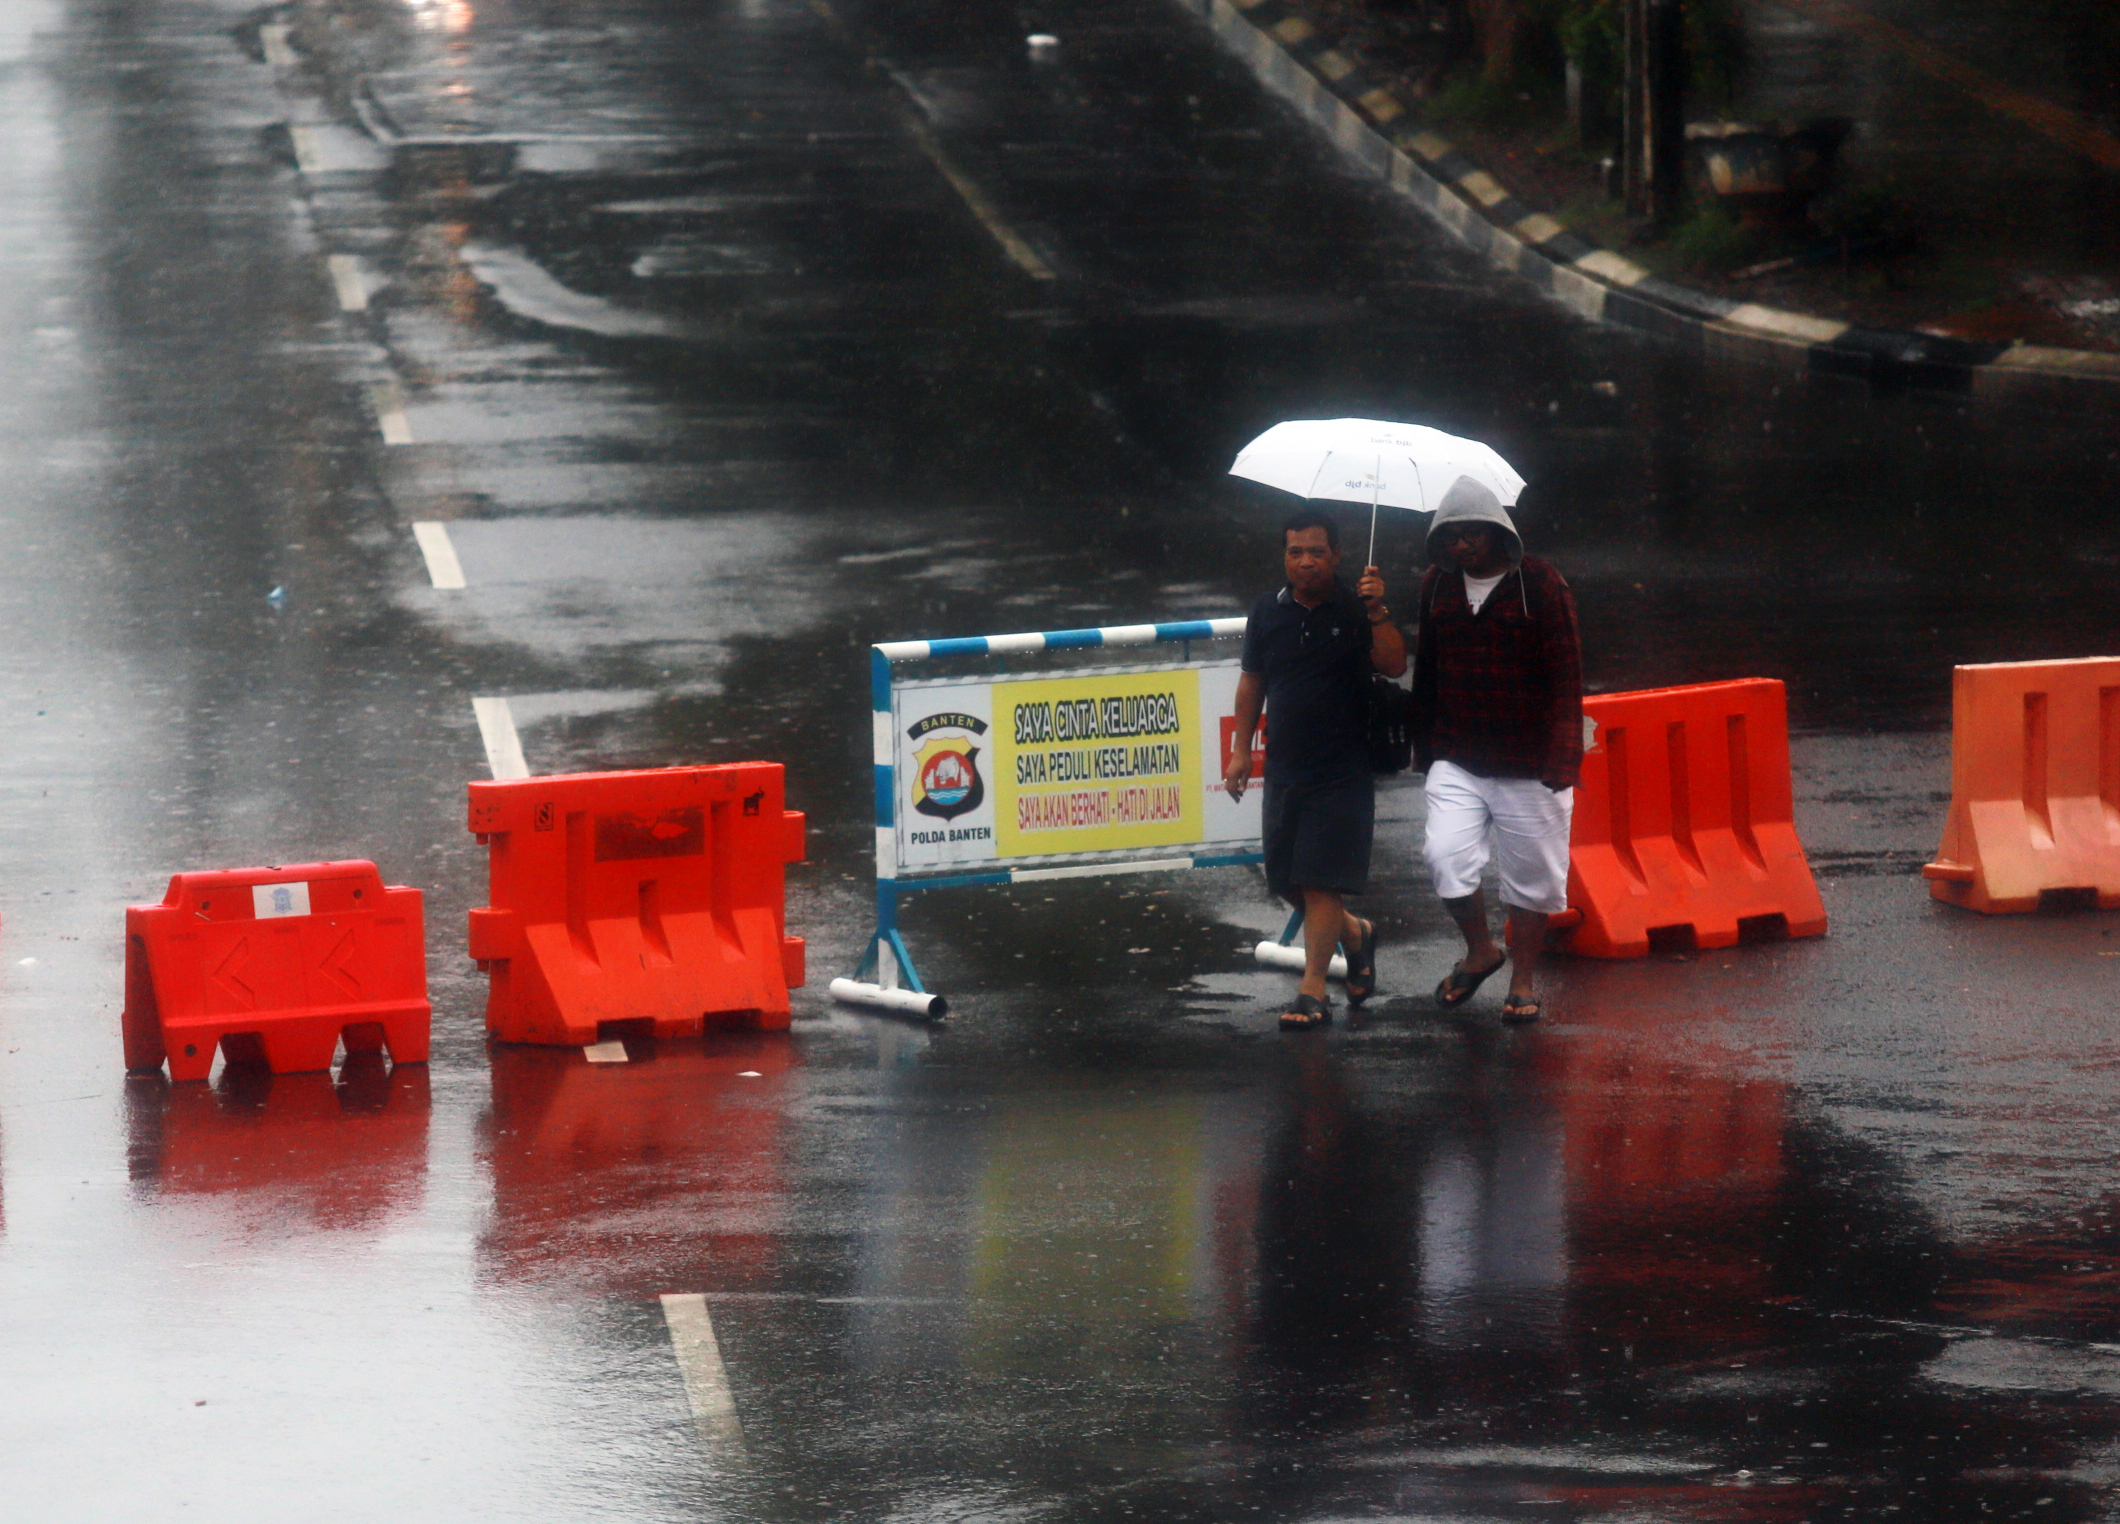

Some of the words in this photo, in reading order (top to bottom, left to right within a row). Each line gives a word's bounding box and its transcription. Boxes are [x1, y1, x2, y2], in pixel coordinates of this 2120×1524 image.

[921, 715, 975, 731] BANTEN
[1015, 703, 1054, 744] SAYA
[1055, 698, 1100, 742] CINTA
[1100, 692, 1180, 738] KELUARGA
[1016, 753, 1047, 785] SAYA
[1048, 750, 1092, 782] PEDULI
[1094, 743, 1180, 779] KESELAMATAN
[1018, 796, 1042, 830] SAYA
[1043, 794, 1069, 828] AKAN
[1070, 790, 1110, 826] BERHATI
[1116, 788, 1138, 823] HATI
[1139, 787, 1149, 821] DI
[1150, 785, 1180, 820] JALAN
[911, 830, 946, 845] POLDA
[948, 826, 991, 842] BANTEN
